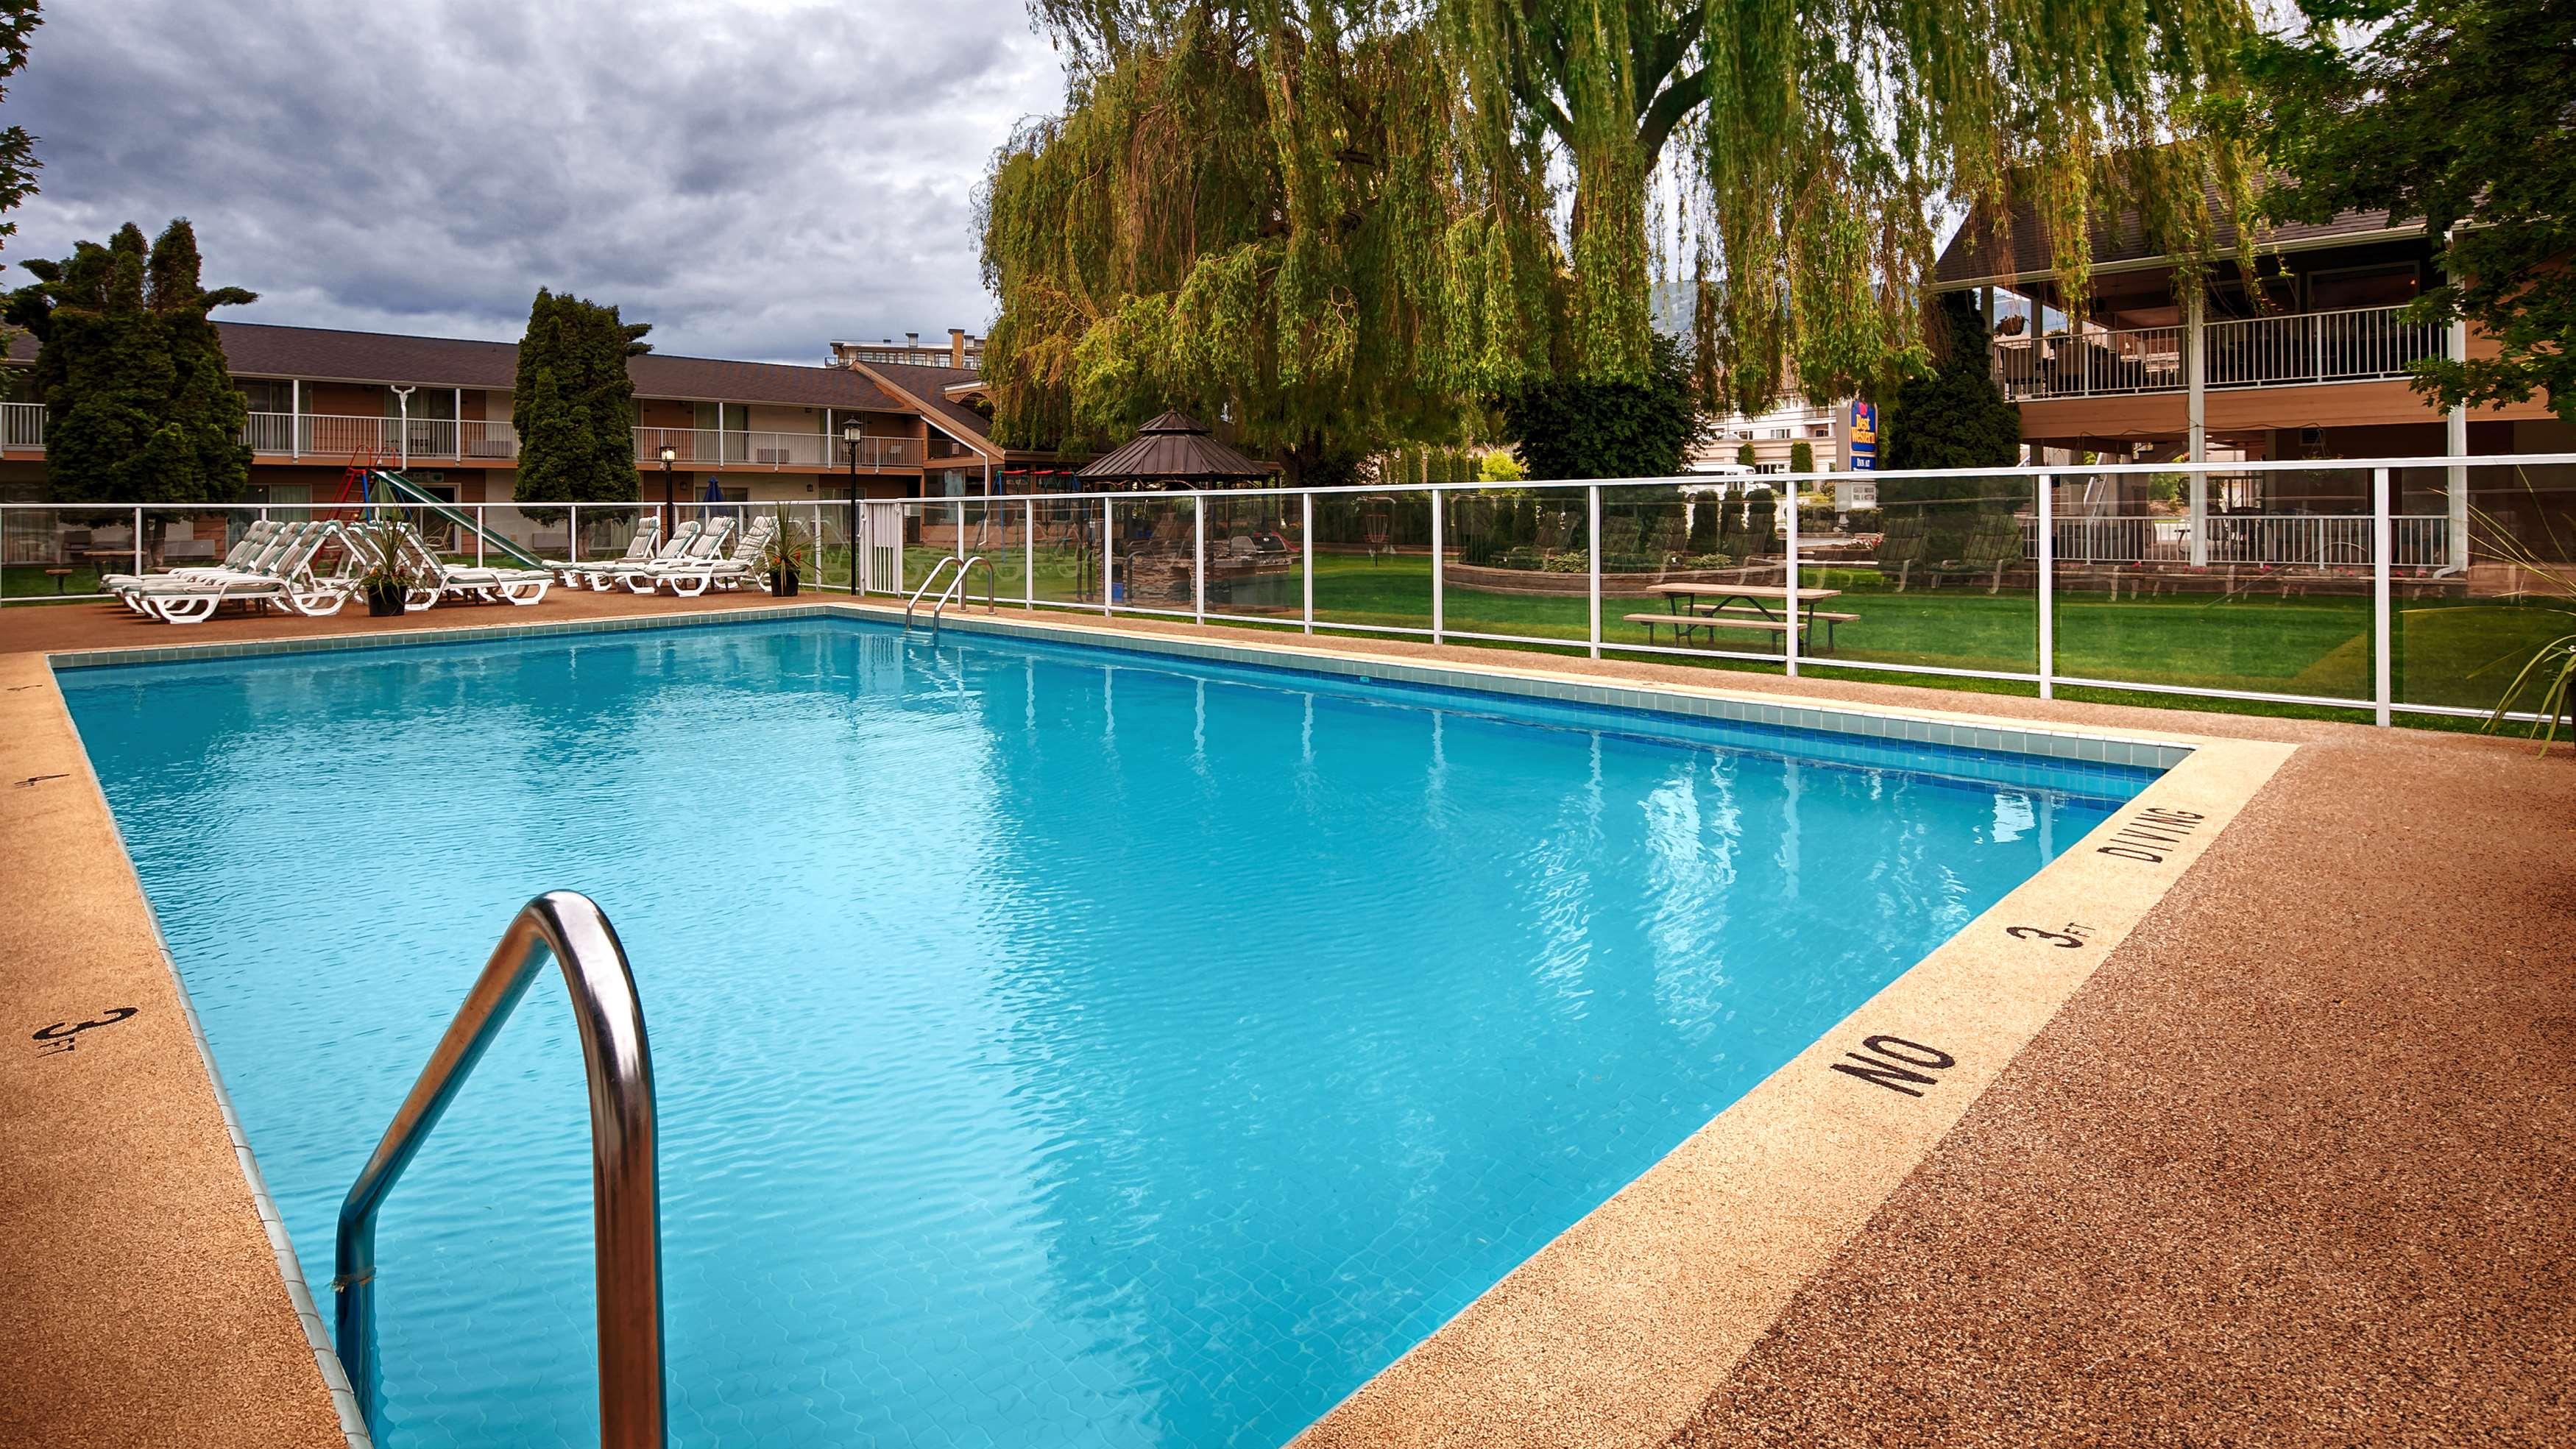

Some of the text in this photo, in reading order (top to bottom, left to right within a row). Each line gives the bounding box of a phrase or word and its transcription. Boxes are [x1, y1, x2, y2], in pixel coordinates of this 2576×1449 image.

[1851, 427, 1875, 444] Western
[1856, 414, 1870, 431] Best
[2096, 808, 2205, 863] DIVING
[2006, 922, 2097, 949] 3 FT
[32, 1007, 140, 1058] 3 FT
[1830, 1035, 1956, 1098] NO
